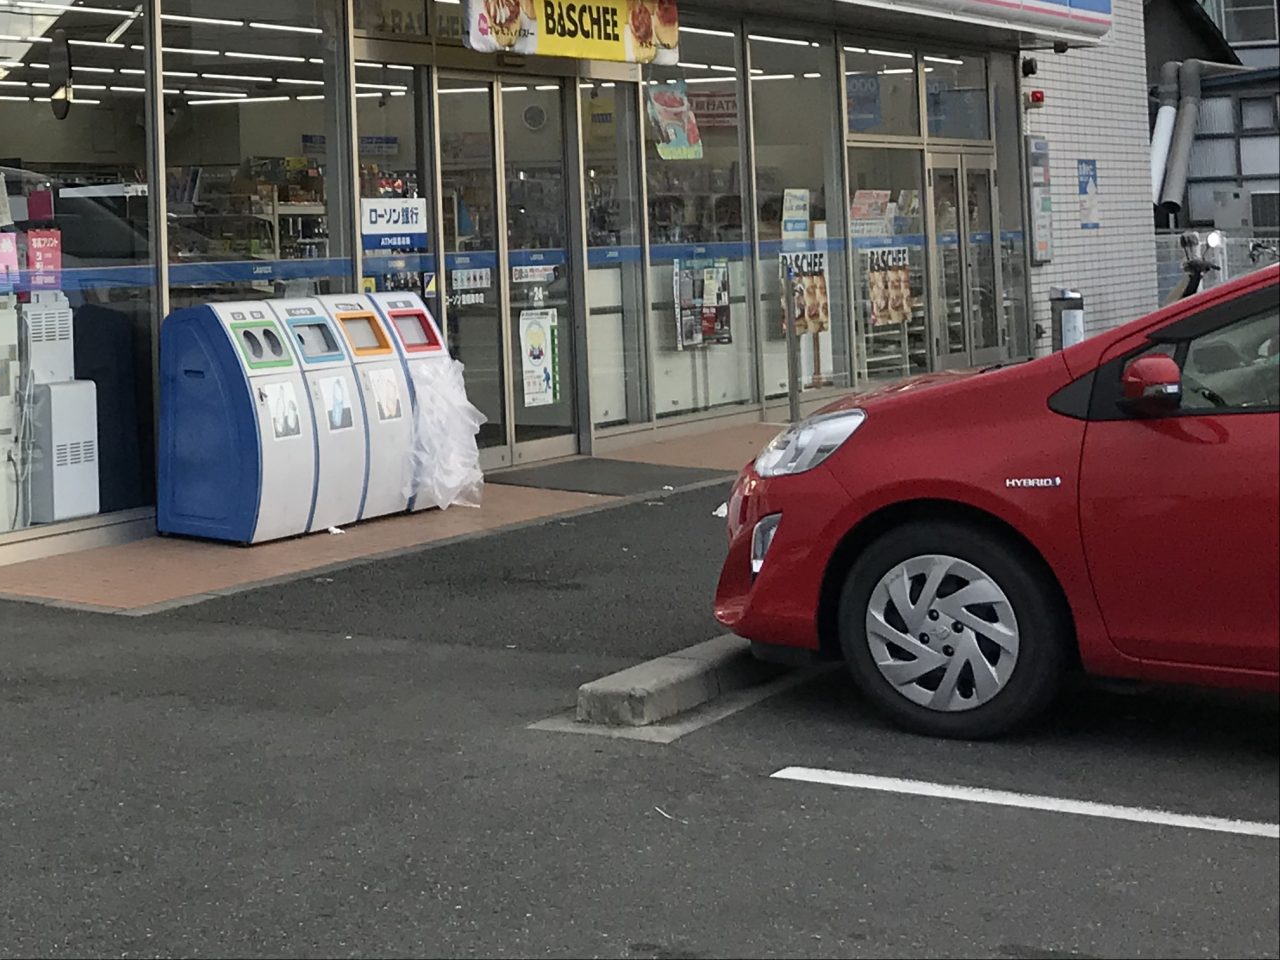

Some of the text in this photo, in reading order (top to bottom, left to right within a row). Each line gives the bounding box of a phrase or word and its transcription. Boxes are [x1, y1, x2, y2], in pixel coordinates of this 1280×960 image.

[543, 0, 620, 42] BASCHEE
[369, 207, 419, 225] ローソン銀行
[1006, 478, 1053, 487] HYBRID
